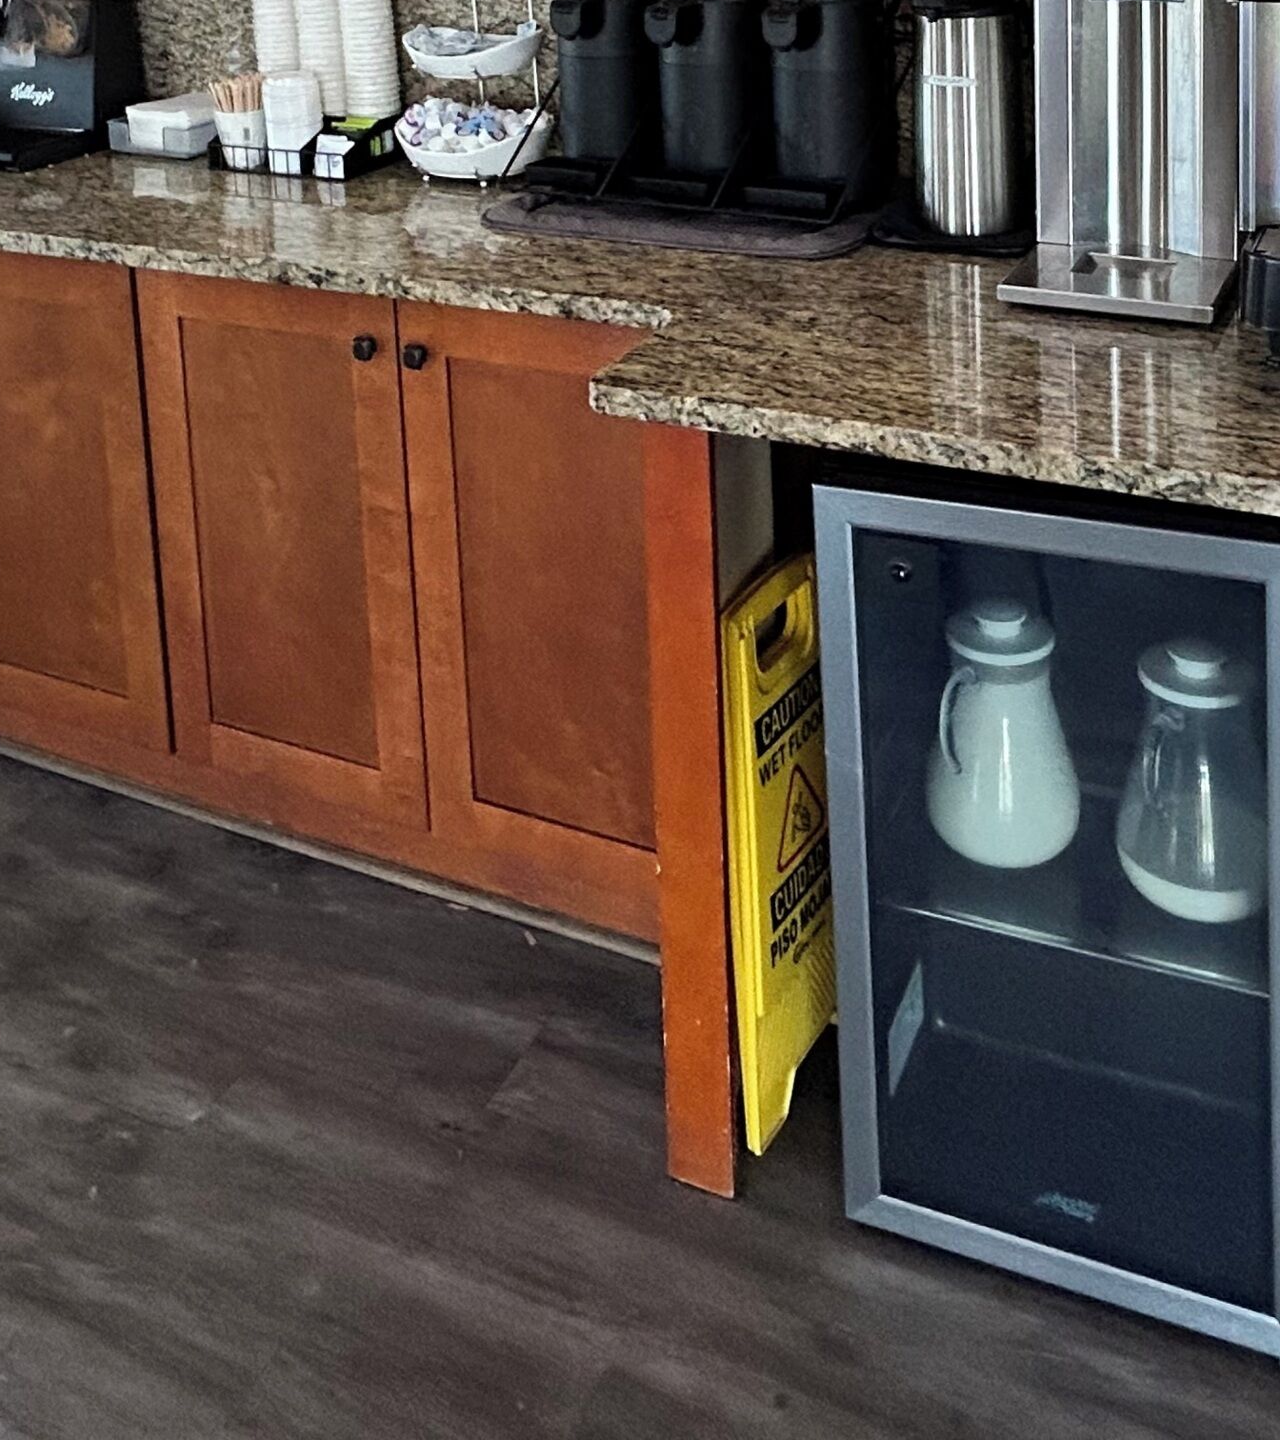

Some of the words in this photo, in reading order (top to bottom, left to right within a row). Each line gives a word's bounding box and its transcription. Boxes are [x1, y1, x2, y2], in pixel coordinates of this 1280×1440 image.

[761, 672, 820, 746] CAUTION
[758, 743, 786, 788] WET
[774, 842, 828, 921] CUIDAD
[770, 917, 799, 970] PISO
